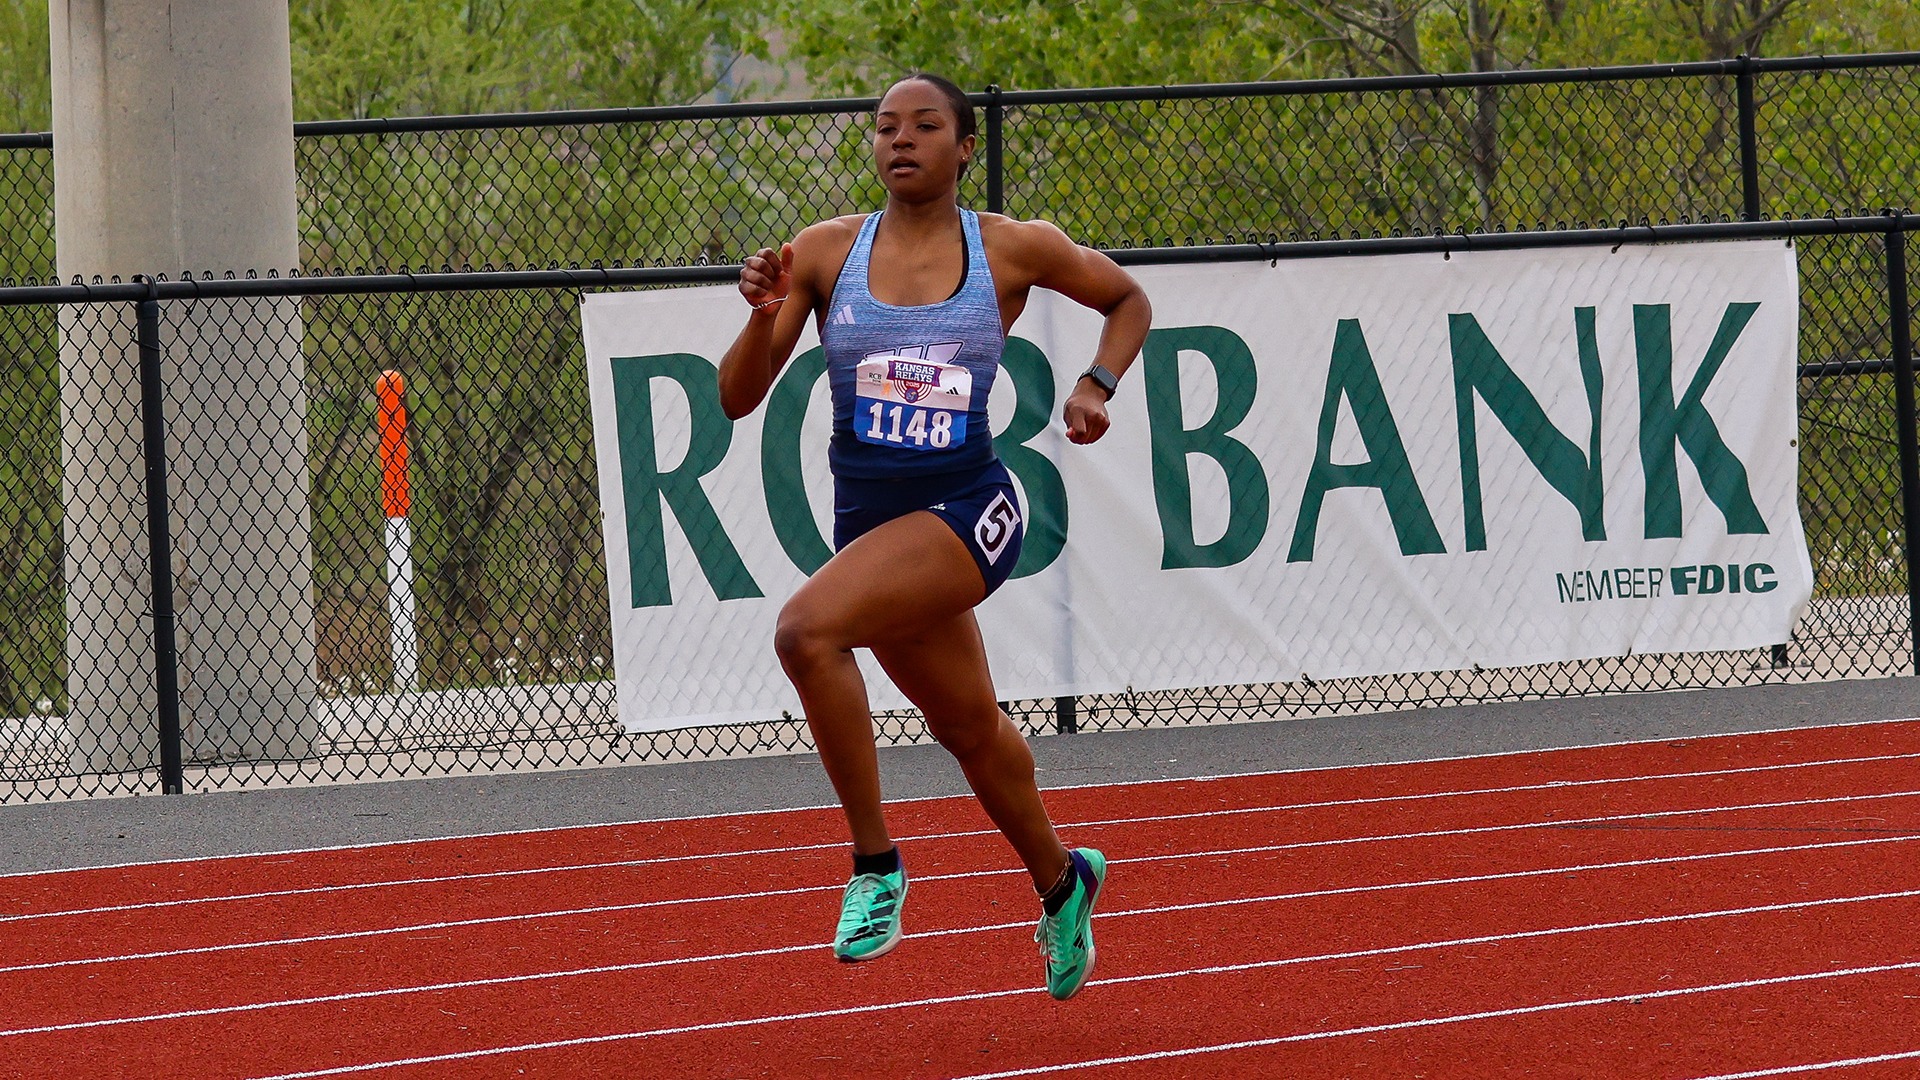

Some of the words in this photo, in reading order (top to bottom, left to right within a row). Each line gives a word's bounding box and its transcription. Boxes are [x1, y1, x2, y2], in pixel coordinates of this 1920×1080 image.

[895, 362, 935, 375] KANSAS
[895, 370, 933, 383] RELAYS
[867, 402, 952, 448] 1148
[1143, 302, 1770, 570] BANK
[980, 498, 1014, 552] 5
[1556, 567, 1664, 603] MEMBER
[1670, 562, 1779, 596] FDIC
